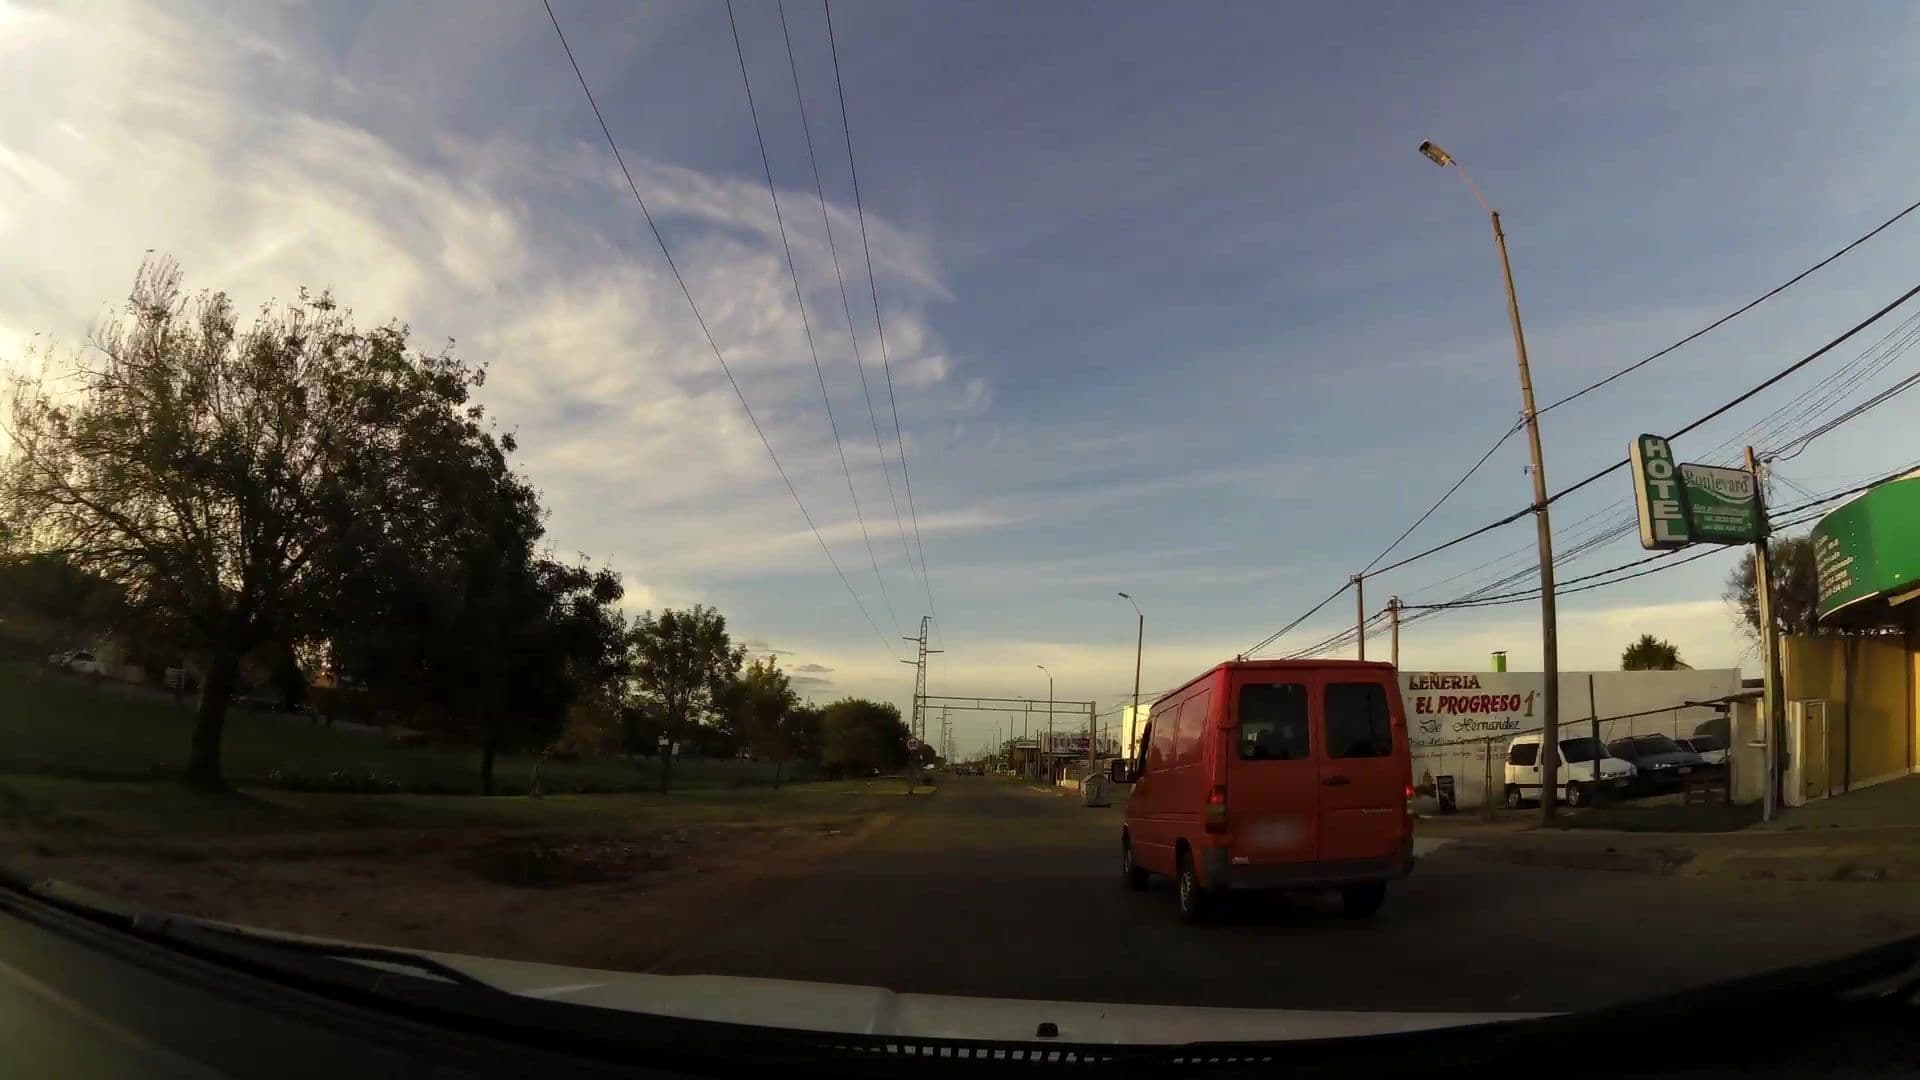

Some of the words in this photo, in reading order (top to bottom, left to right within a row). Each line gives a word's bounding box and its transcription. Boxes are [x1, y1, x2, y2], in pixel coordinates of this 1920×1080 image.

[1645, 439, 1688, 541] HOTEL
[1682, 470, 1751, 494] Boulevard
[1409, 672, 1481, 690] LEÑERIA
[1416, 696, 1434, 715] EL
[1437, 694, 1521, 716] PROGRESO
